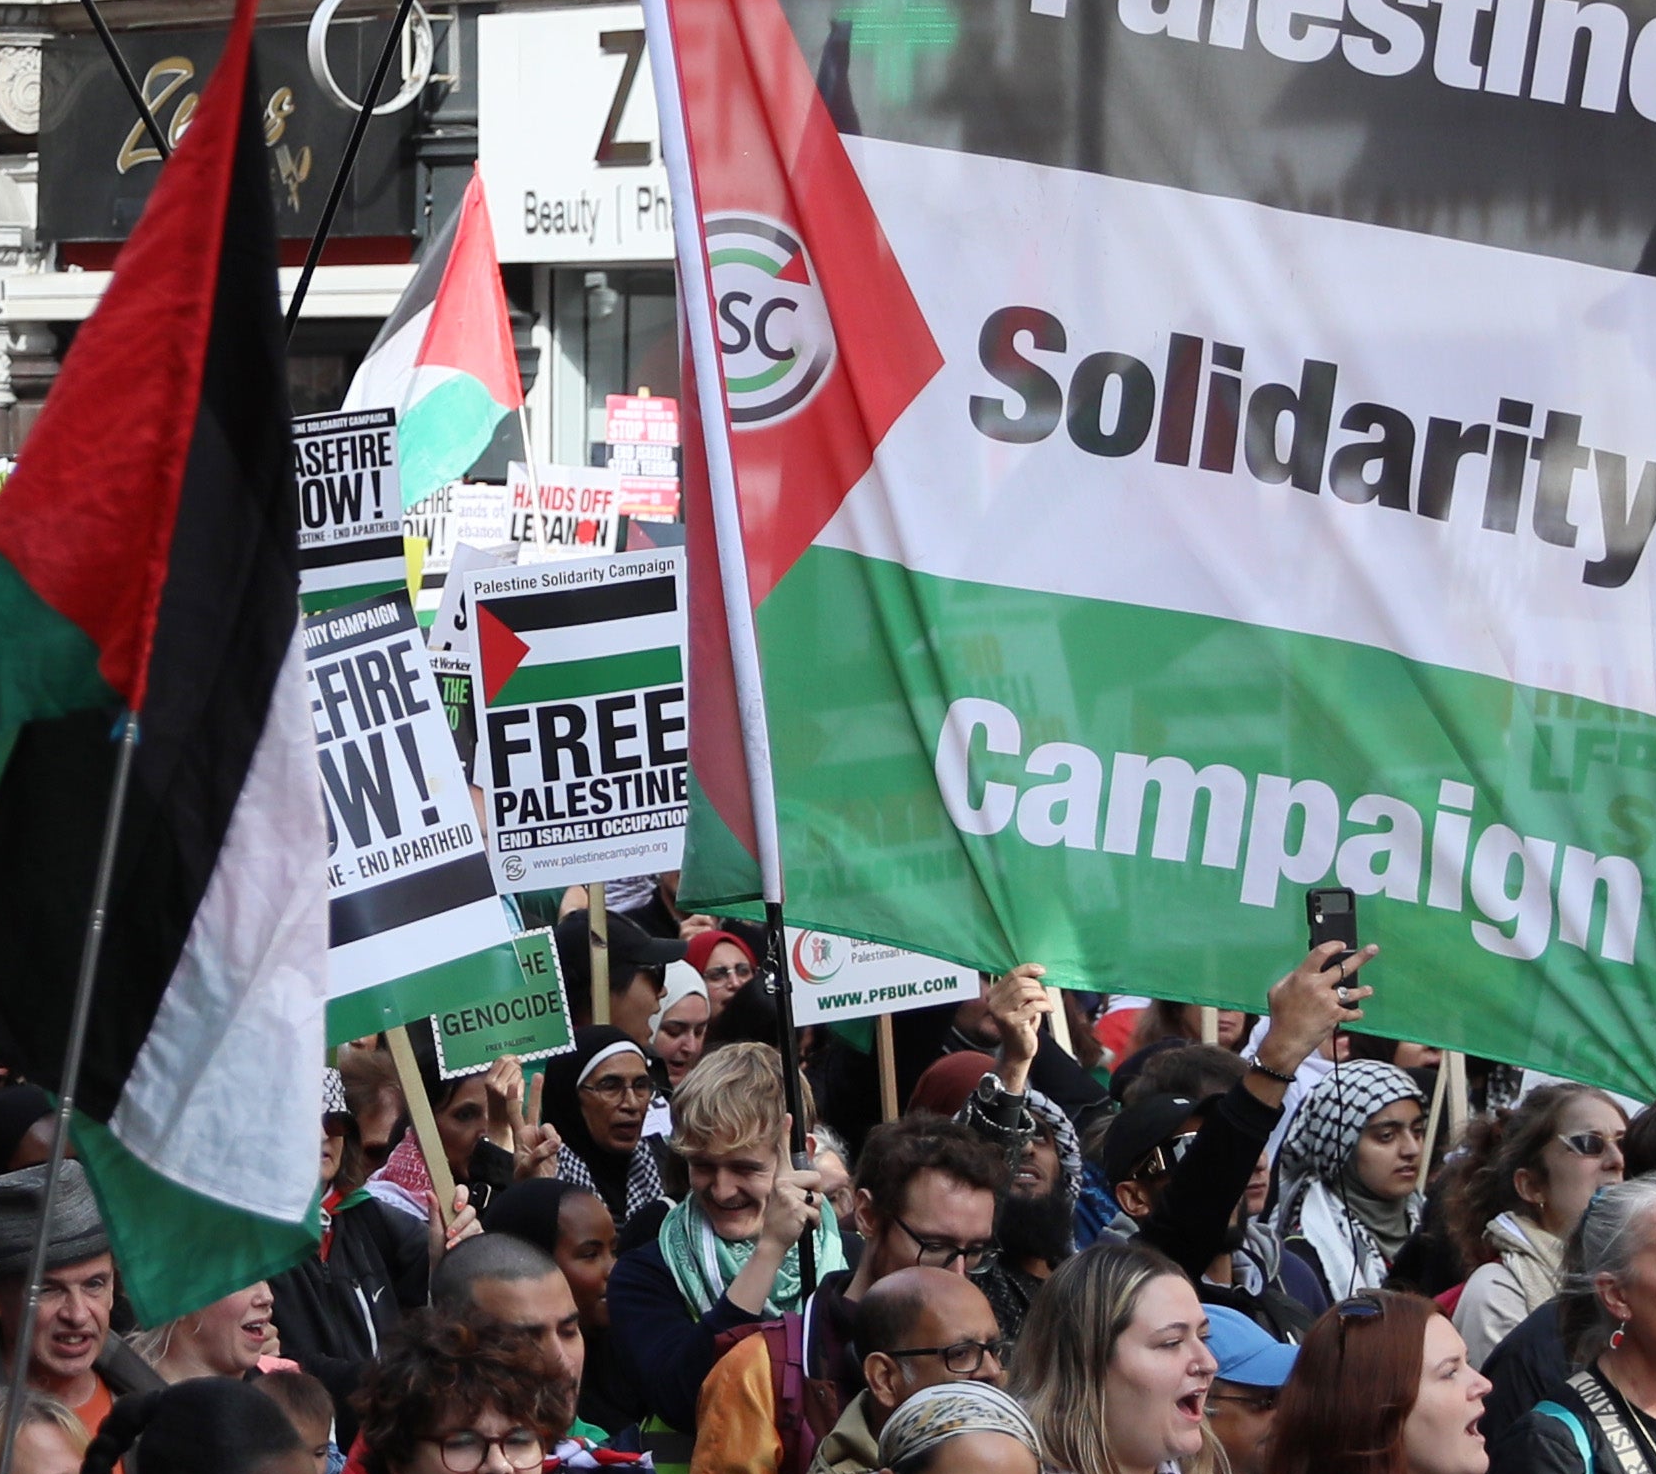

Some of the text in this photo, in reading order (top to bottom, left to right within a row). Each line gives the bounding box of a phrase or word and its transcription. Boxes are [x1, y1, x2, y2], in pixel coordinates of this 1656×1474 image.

[523, 190, 601, 242] Beauty
[348, 412, 388, 428] CAMPAIGN
[580, 488, 614, 514] OFF
[333, 527, 351, 539] END
[352, 520, 399, 537] APARTHEID
[474, 557, 676, 595] Palestine Solidarity Campaign
[331, 602, 401, 641] CAMPAIGN
[440, 657, 472, 672] Worker
[441, 676, 471, 705] THE
[486, 687, 688, 790] FREE
[493, 766, 688, 828] PALESTINE
[499, 822, 599, 852] END ISRAELI
[933, 694, 1641, 966] Campaign
[359, 822, 475, 879] END APARTHEID
[532, 842, 668, 870] www.palestinecampaign.org
[817, 975, 958, 1011] WWW.PFBUK.COM
[442, 990, 561, 1037] GENOCIDE
[1575, 1378, 1640, 1456] ISLAND
